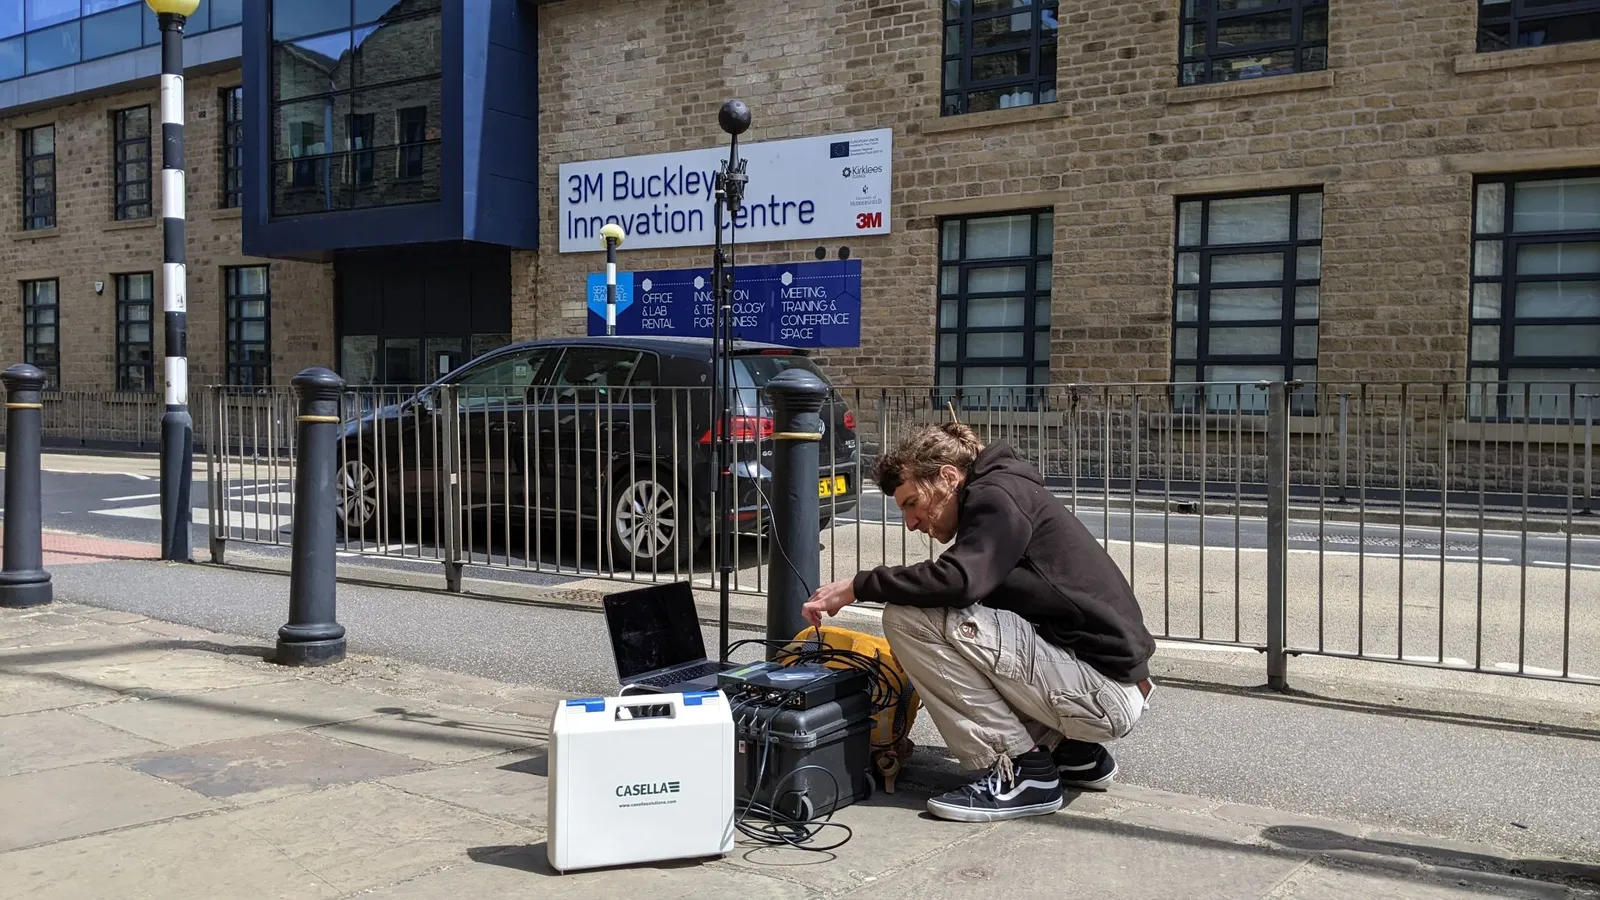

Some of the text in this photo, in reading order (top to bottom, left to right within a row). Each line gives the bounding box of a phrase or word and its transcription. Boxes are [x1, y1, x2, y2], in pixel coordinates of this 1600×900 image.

[852, 165, 883, 175] Kirklees
[568, 165, 716, 204] 3M Buckley
[856, 212, 882, 229] 3M
[642, 293, 673, 304] OFFICE
[694, 289, 750, 302] INNOON
[781, 286, 827, 299] MEETING,
[642, 305, 667, 317] & LAB
[694, 302, 765, 315] & TEOLOGY
[781, 300, 837, 312] TRAINING &
[642, 318, 675, 329] RENTAL
[694, 317, 715, 328] FOR
[781, 313, 850, 326] CONFERENCE
[781, 328, 814, 339] SPACE
[616, 782, 668, 797] CASELLA
